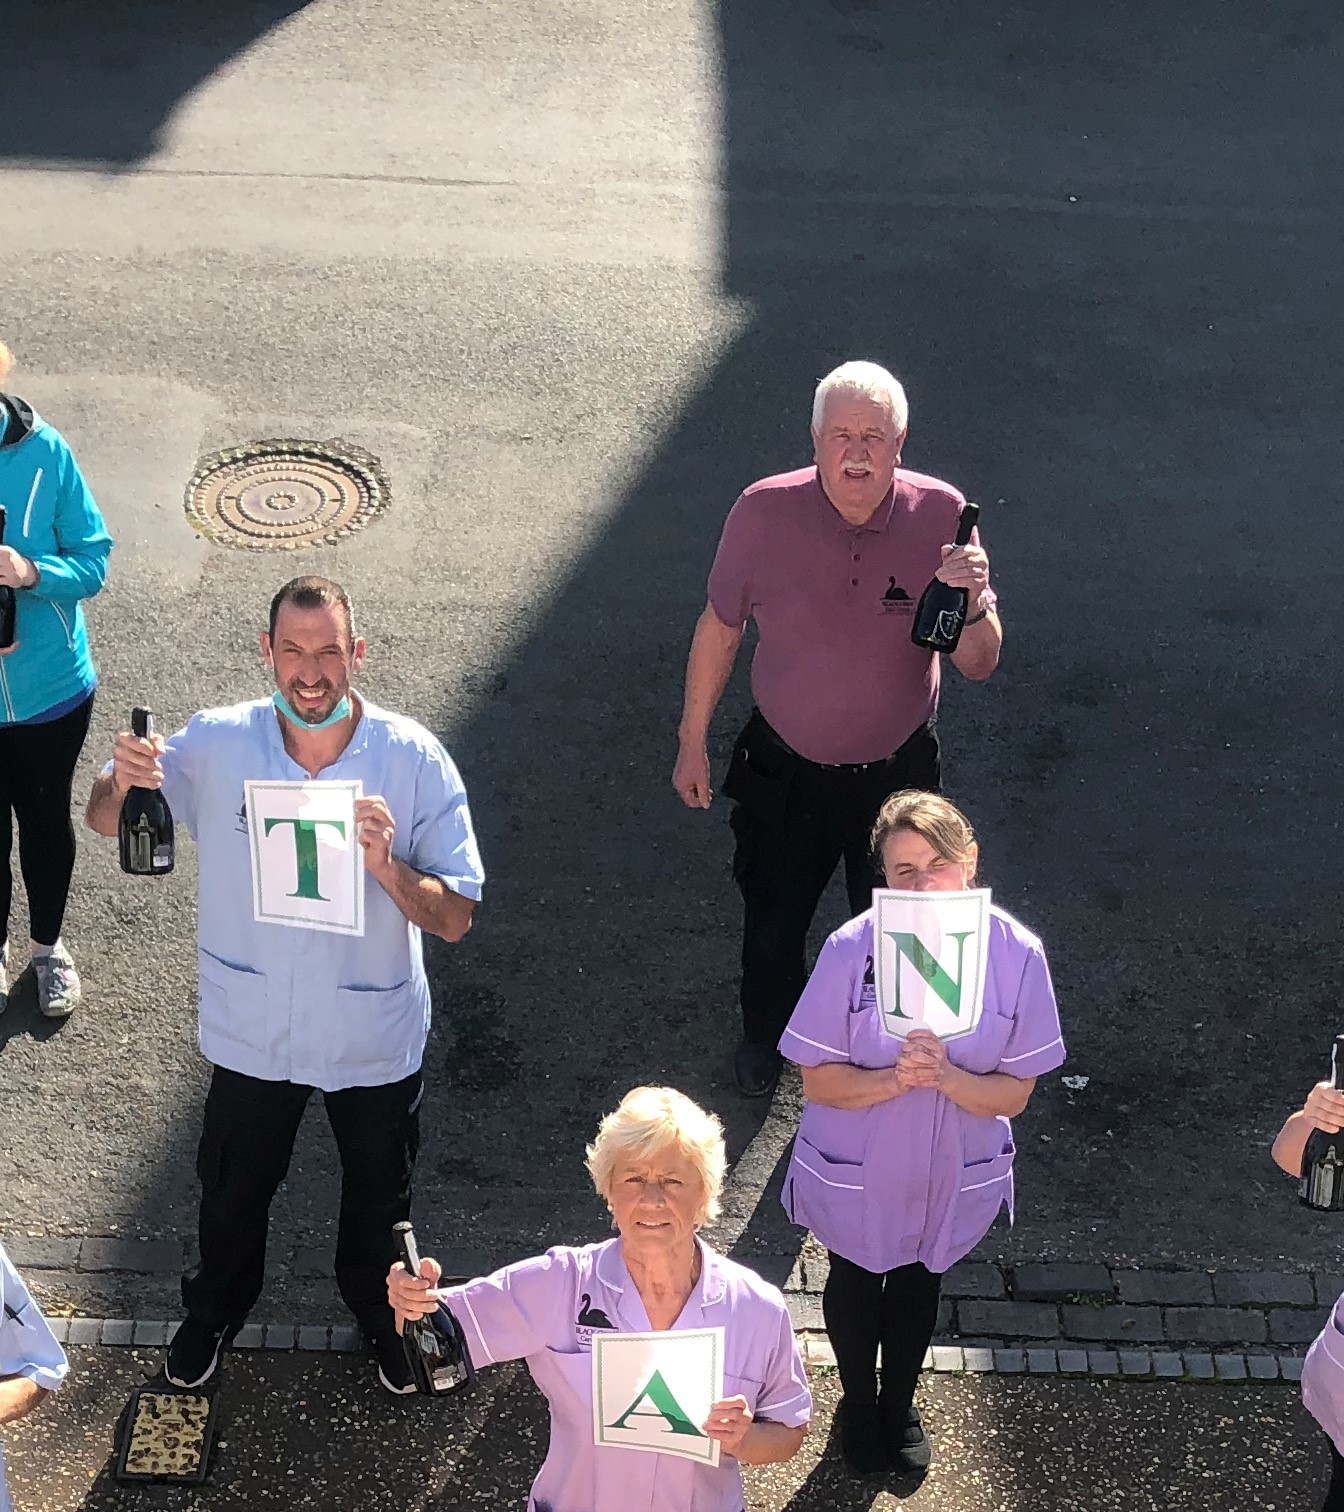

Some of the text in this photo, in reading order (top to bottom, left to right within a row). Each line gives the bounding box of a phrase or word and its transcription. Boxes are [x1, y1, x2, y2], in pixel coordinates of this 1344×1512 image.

[264, 818, 346, 899] T
[882, 931, 975, 1018] N
[606, 1369, 708, 1438] A
